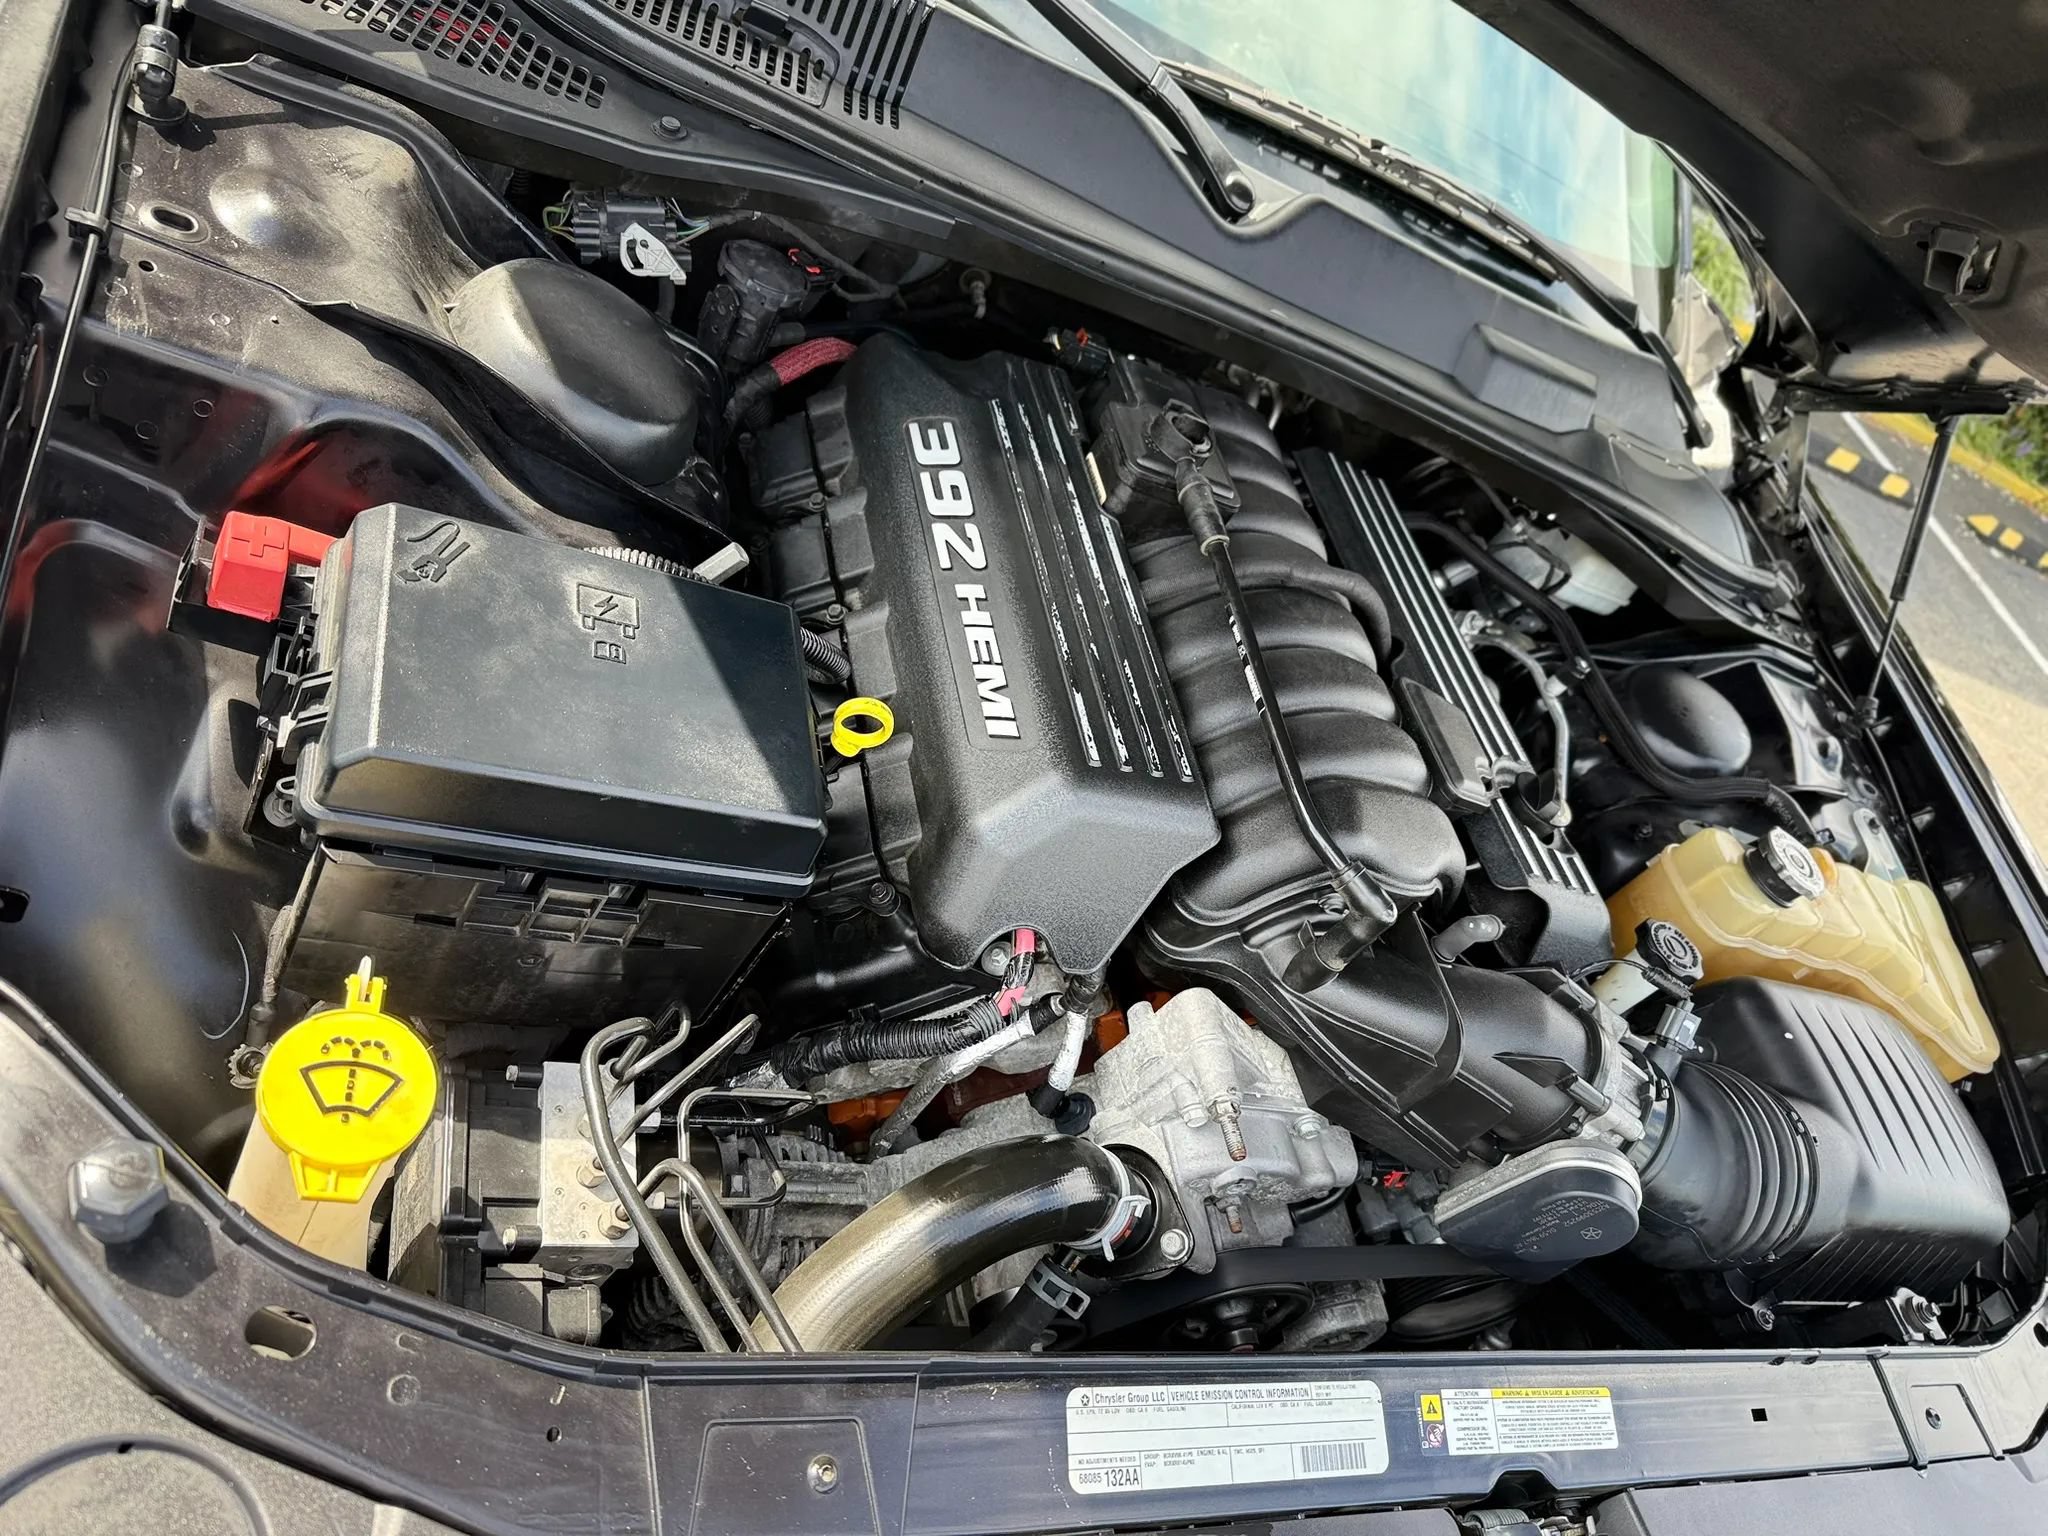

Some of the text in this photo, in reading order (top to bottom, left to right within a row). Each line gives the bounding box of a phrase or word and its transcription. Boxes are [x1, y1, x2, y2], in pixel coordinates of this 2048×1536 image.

[909, 422, 1021, 739] 392 HEMI
[1095, 1391, 1165, 1405] Chrysler Group LLC
[1170, 1391, 1199, 1402] VEHICLE
[1201, 1389, 1233, 1401] EMISSION
[1235, 1388, 1264, 1400] CONTROL
[1265, 1387, 1309, 1399] INFORMATION
[1079, 1468, 1140, 1487] 68085 132AA
